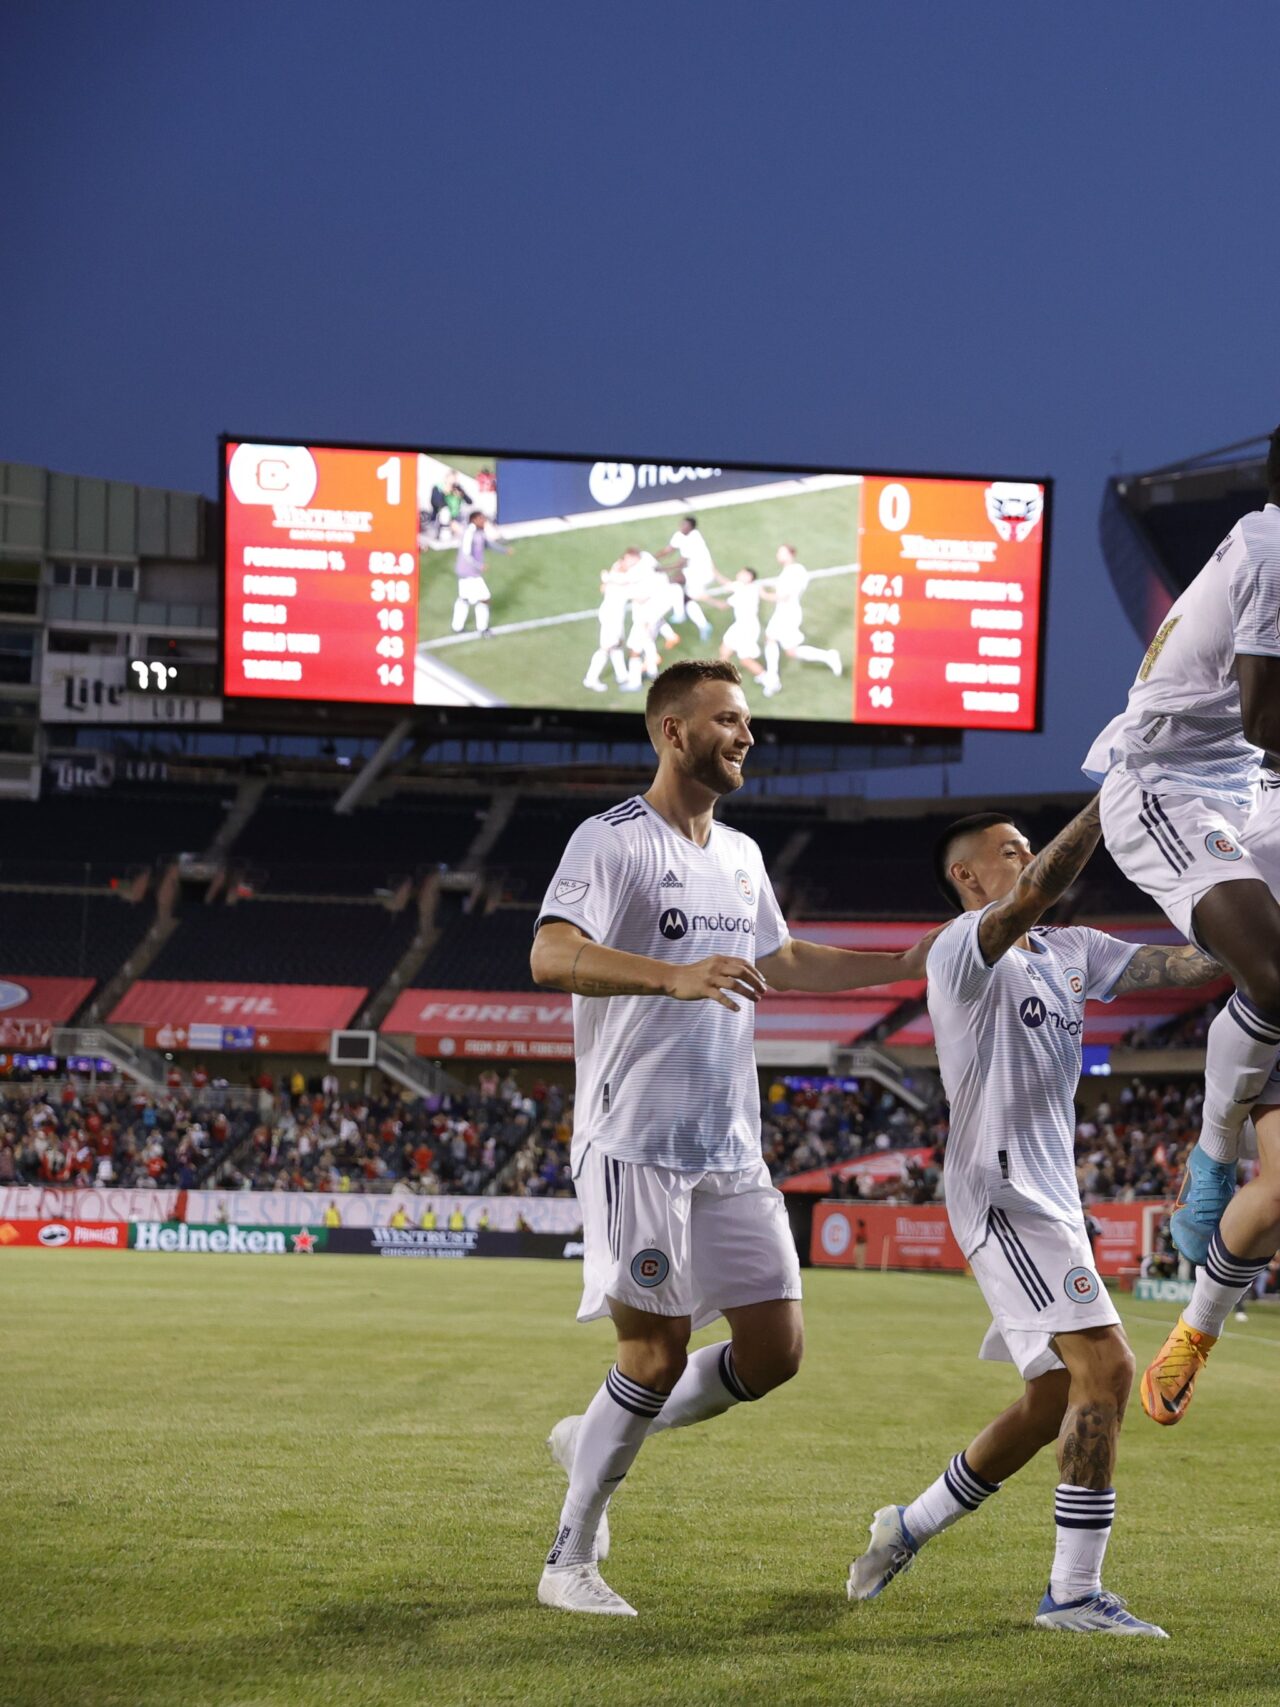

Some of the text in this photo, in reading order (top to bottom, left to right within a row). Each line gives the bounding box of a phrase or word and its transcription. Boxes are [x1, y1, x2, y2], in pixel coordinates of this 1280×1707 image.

[376, 457, 401, 505] 1
[878, 483, 911, 532] 0
[64, 676, 124, 713] Lite
[135, 1222, 286, 1253] Heineken
[372, 1227, 478, 1245] WINTRUST
